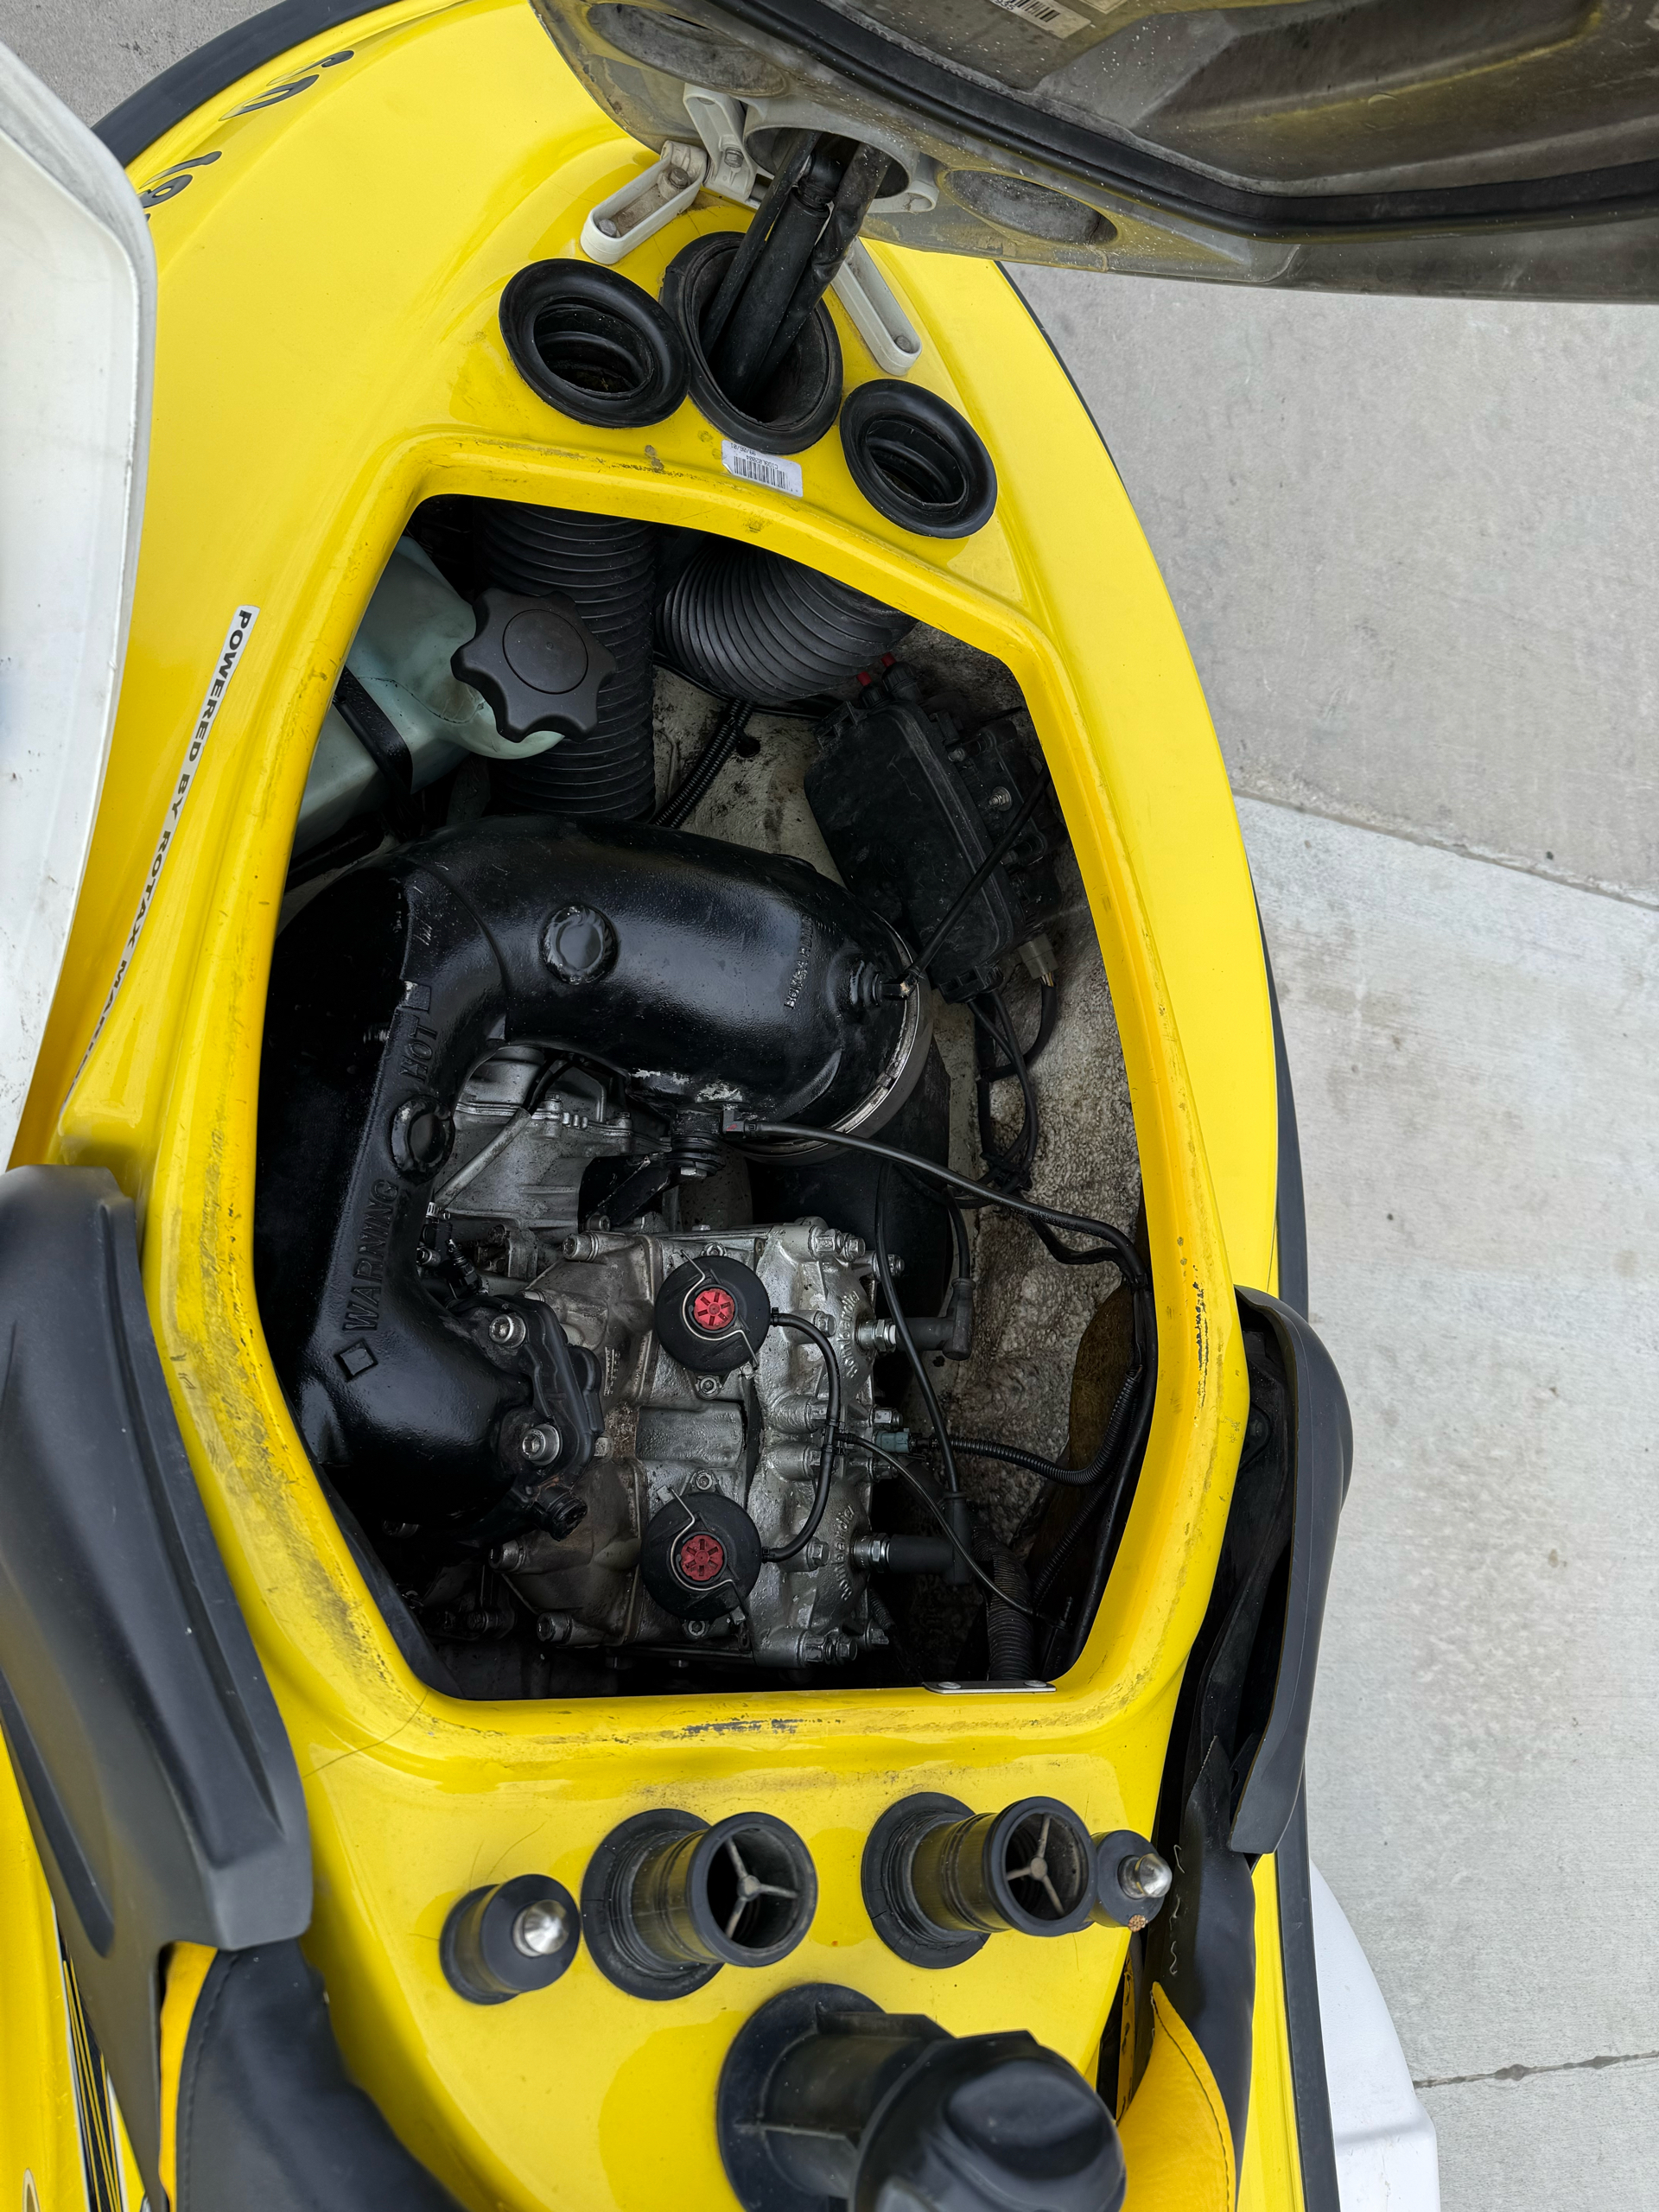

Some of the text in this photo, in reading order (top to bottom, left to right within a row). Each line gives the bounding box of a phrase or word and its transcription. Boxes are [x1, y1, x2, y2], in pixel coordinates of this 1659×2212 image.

[188, 609, 252, 762] POWERED
[171, 773, 191, 820] BY
[127, 830, 171, 948] ROTAX
[343, 1014, 437, 1332] WARNING HOT
